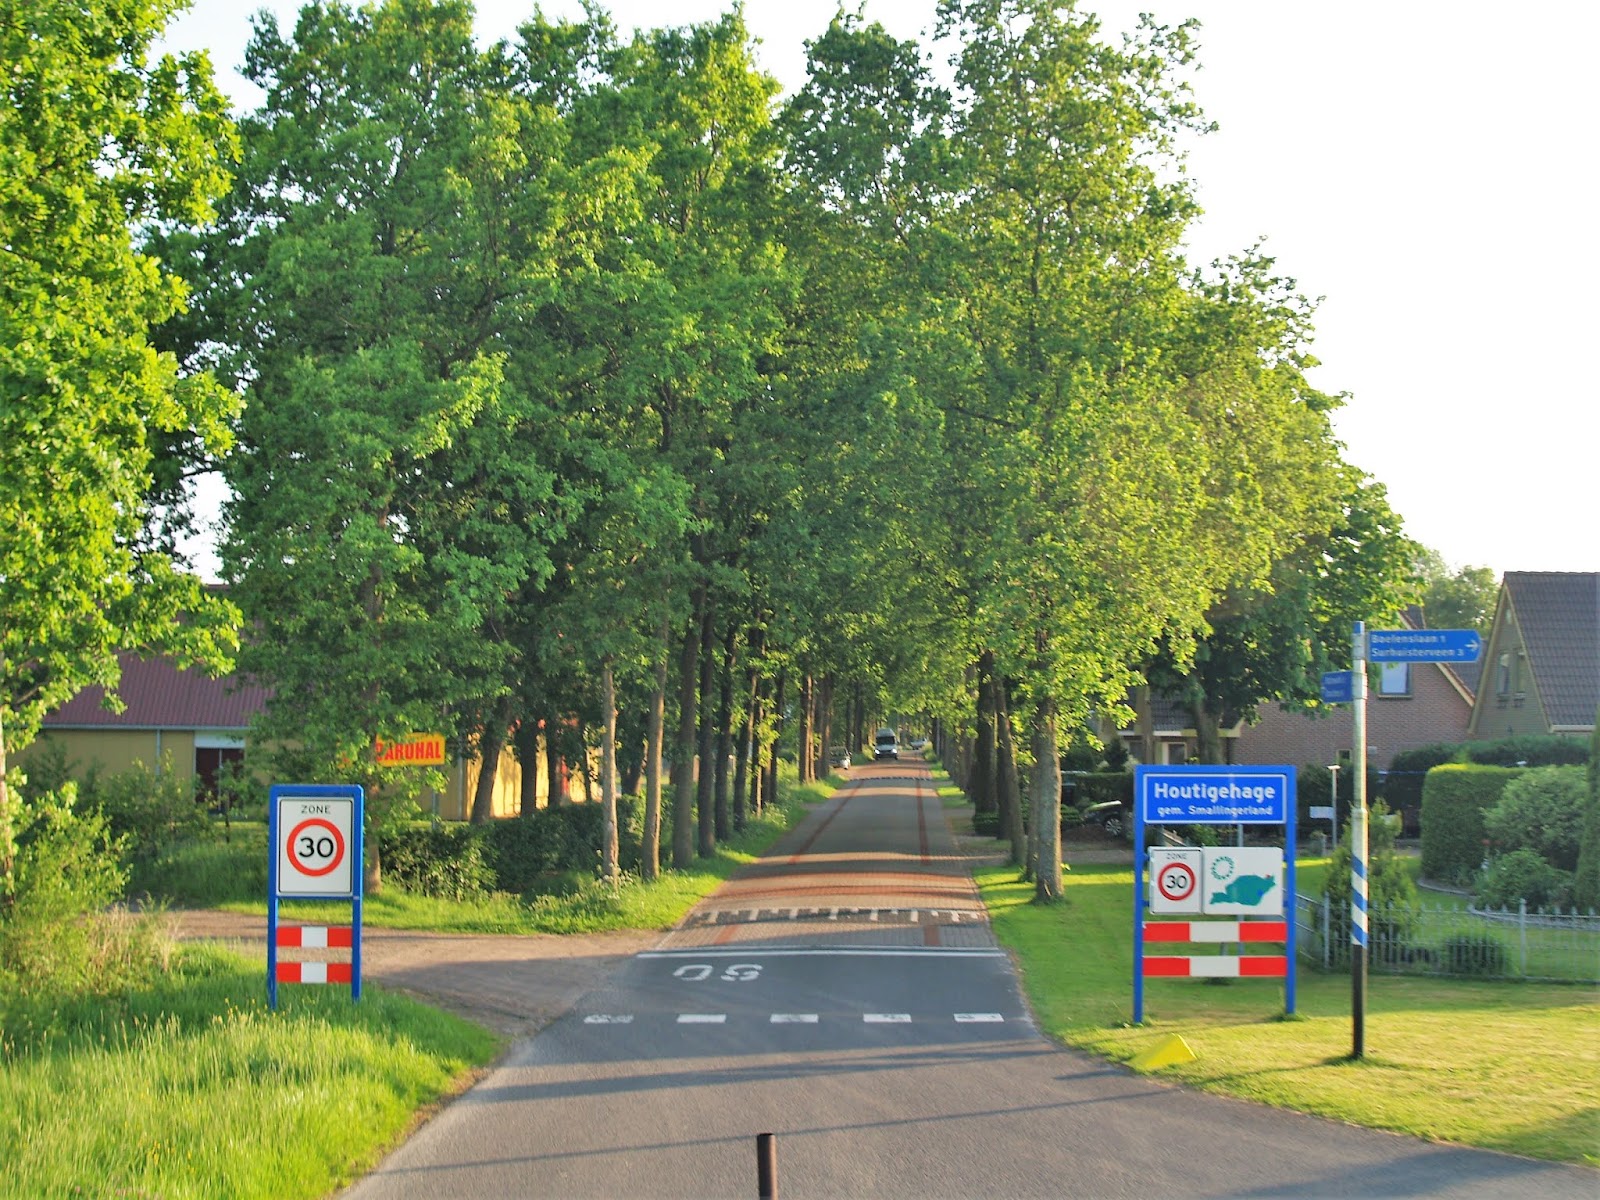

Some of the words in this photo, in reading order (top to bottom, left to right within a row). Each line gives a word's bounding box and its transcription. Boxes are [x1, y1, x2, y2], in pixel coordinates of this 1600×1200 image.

[1154, 782, 1276, 803] Houtigehage
[301, 805, 331, 815] ZONE
[1157, 806, 1185, 817] gem.
[1188, 805, 1273, 817] Smallingerland
[299, 837, 334, 858] 30
[1165, 852, 1188, 860] ZONE
[1165, 875, 1188, 889] 30
